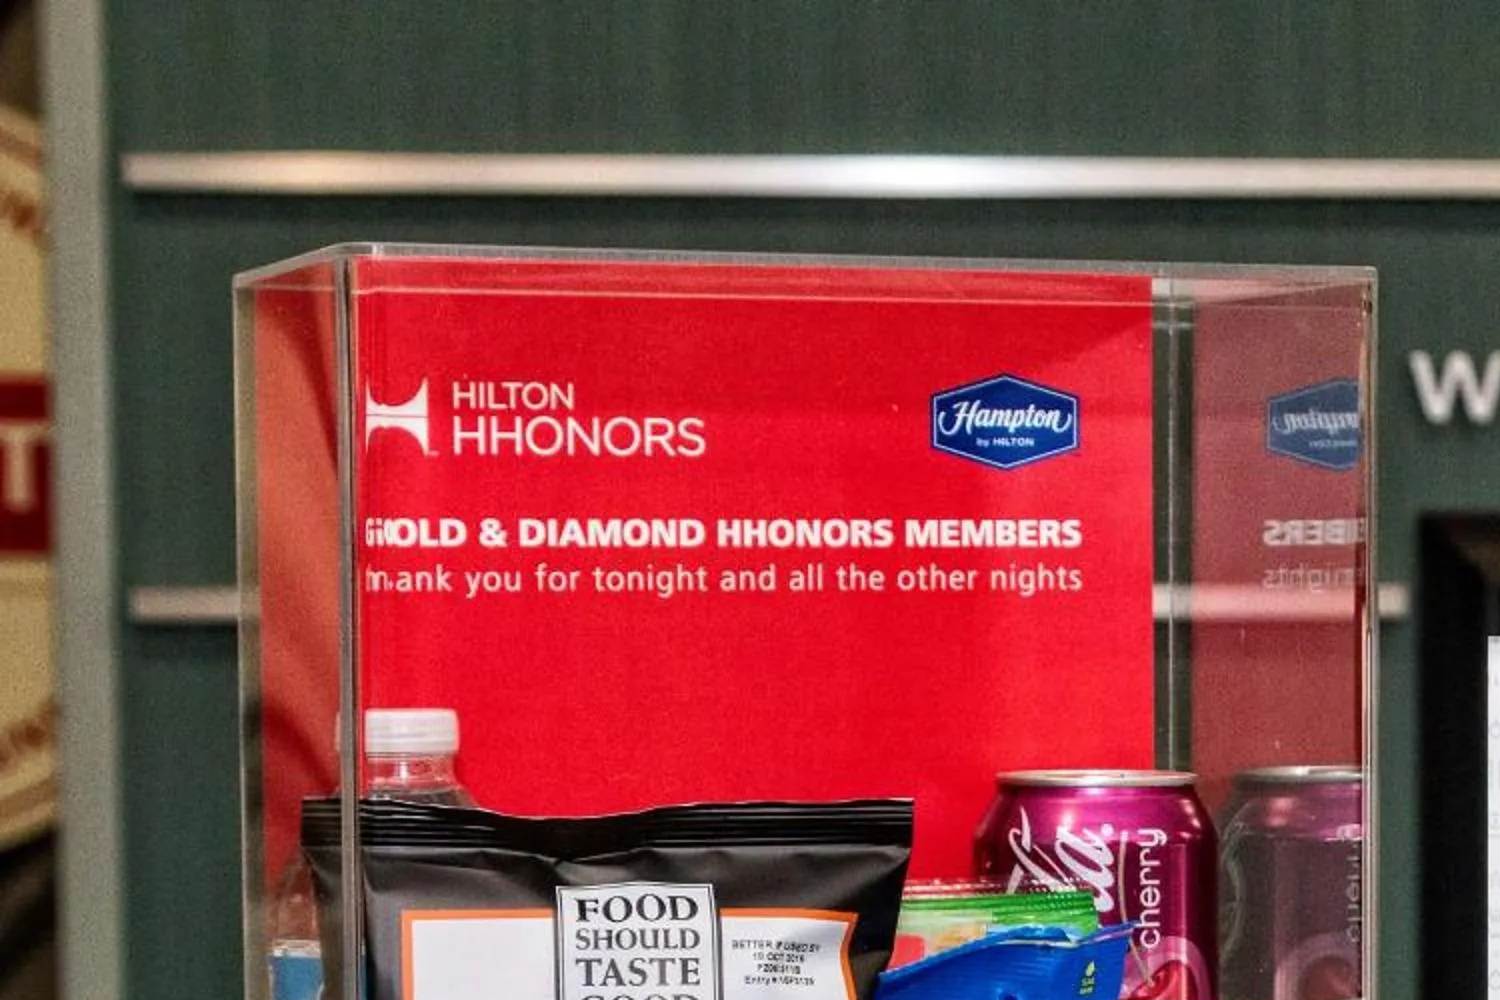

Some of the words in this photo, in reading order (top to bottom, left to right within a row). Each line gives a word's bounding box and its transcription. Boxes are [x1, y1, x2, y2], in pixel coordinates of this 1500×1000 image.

[452, 380, 575, 410] HILTON
[938, 399, 1073, 435] Hampton
[453, 415, 707, 457] HHONORS
[993, 437, 1035, 447] HILTON
[479, 517, 507, 548] &
[519, 517, 707, 548] DIAMOND
[717, 517, 894, 548] HHONORS
[905, 517, 1083, 548] MEMBERS
[465, 569, 522, 598] you
[535, 563, 581, 592] for
[594, 563, 708, 598] tonight
[719, 563, 776, 592] and
[789, 563, 824, 592] all
[836, 563, 885, 592] the
[897, 563, 978, 592] other
[990, 563, 1083, 598] nights
[1137, 828, 1167, 950] cherry
[575, 893, 699, 923] FOOD
[575, 928, 701, 951] SHOULD
[575, 957, 701, 987] TASTE
